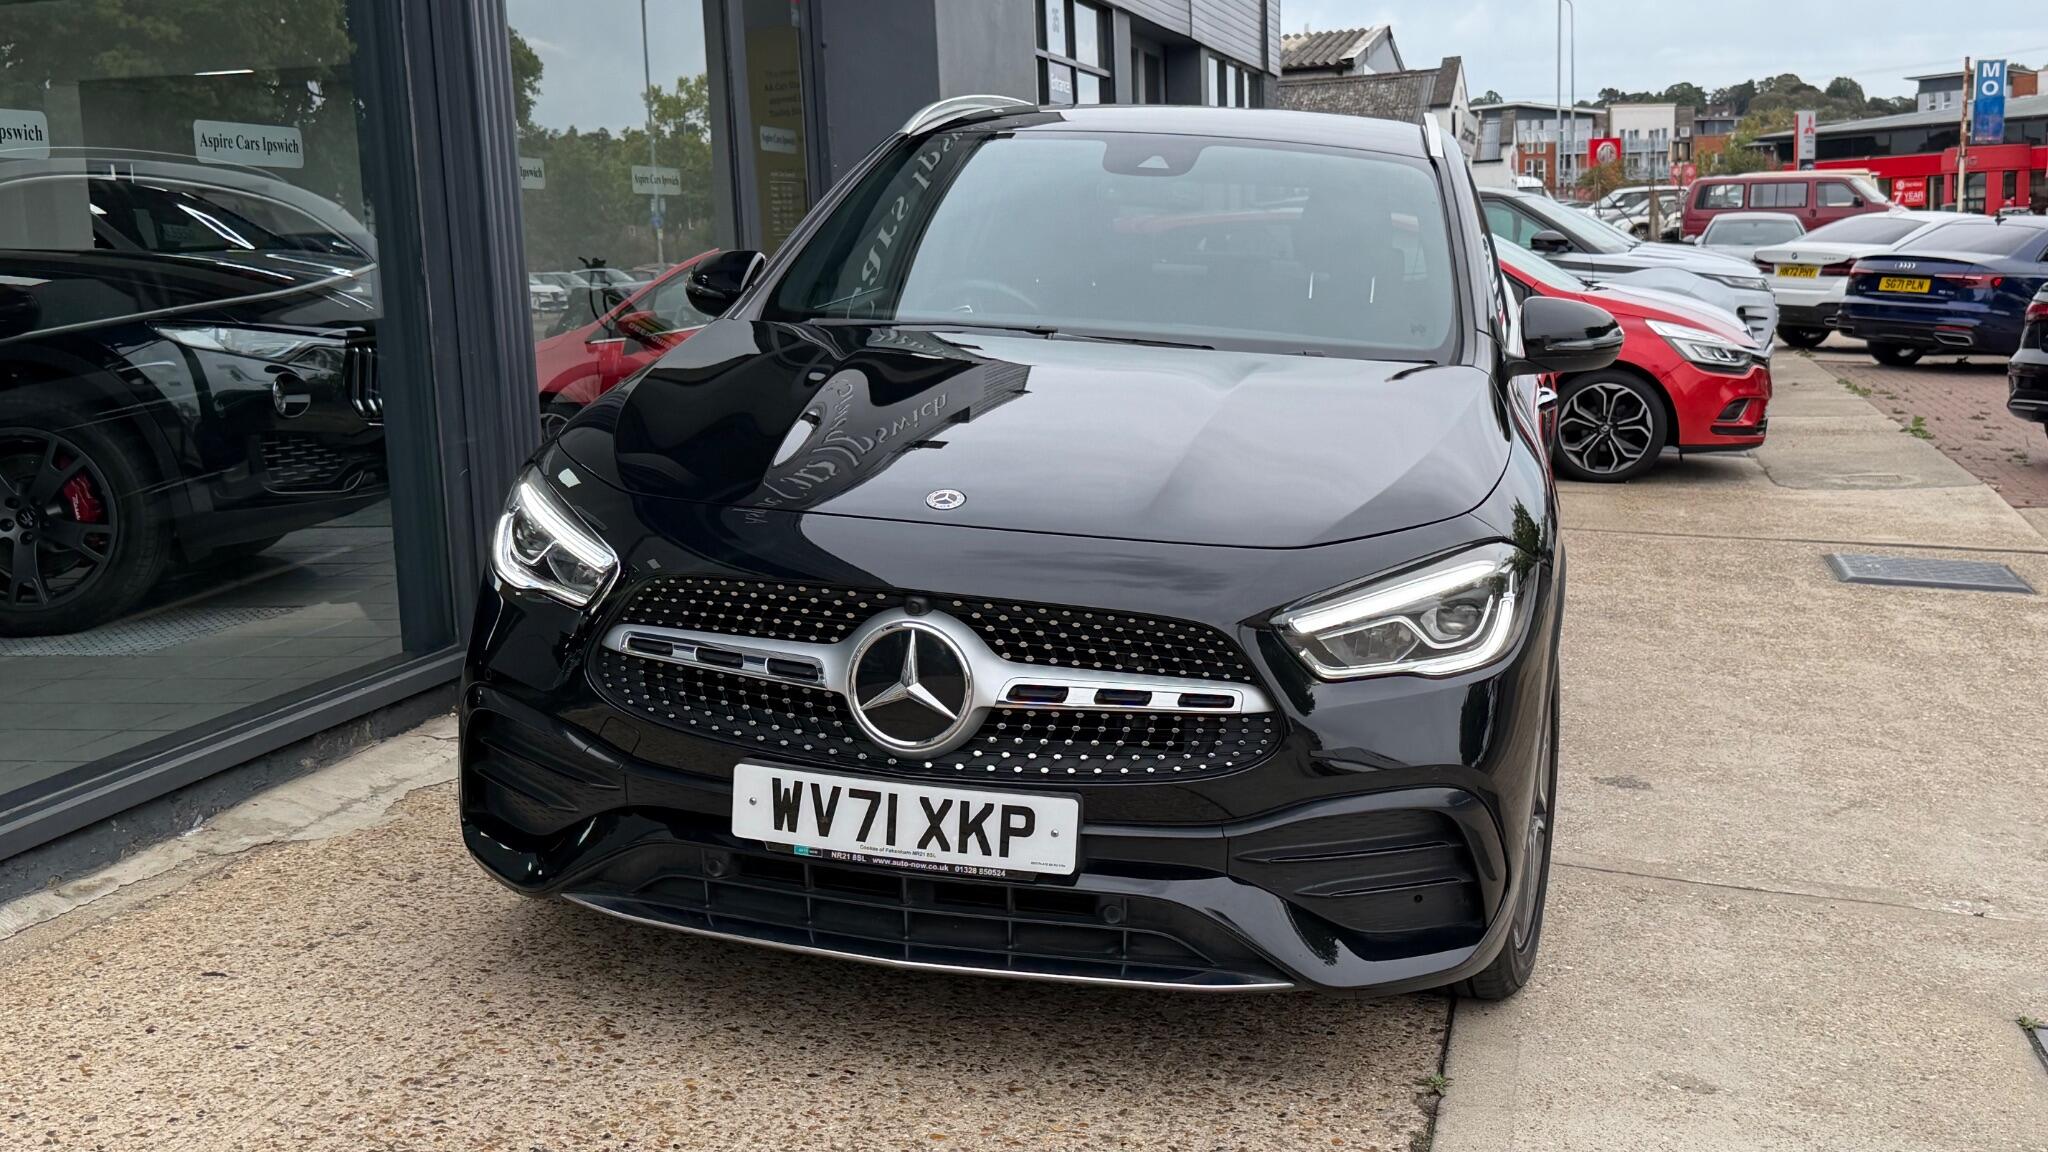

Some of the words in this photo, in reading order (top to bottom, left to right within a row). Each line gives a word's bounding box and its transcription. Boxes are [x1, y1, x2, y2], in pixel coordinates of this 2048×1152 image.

[0, 124, 43, 145] pswich
[200, 132, 234, 151] Aspire
[236, 134, 260, 150] Cars
[263, 136, 299, 155] Ipswich
[520, 166, 543, 180] Ipswich
[1885, 278, 1905, 289] SG71
[1905, 280, 1924, 290] PLN
[771, 777, 898, 847] WV71
[917, 796, 1036, 858] XKP
[831, 851, 850, 861] NR21
[852, 853, 867, 862] 8SL
[872, 857, 949, 872] www.auto-now.co.uk
[954, 867, 977, 875] 01328
[978, 868, 1006, 877] 850524
